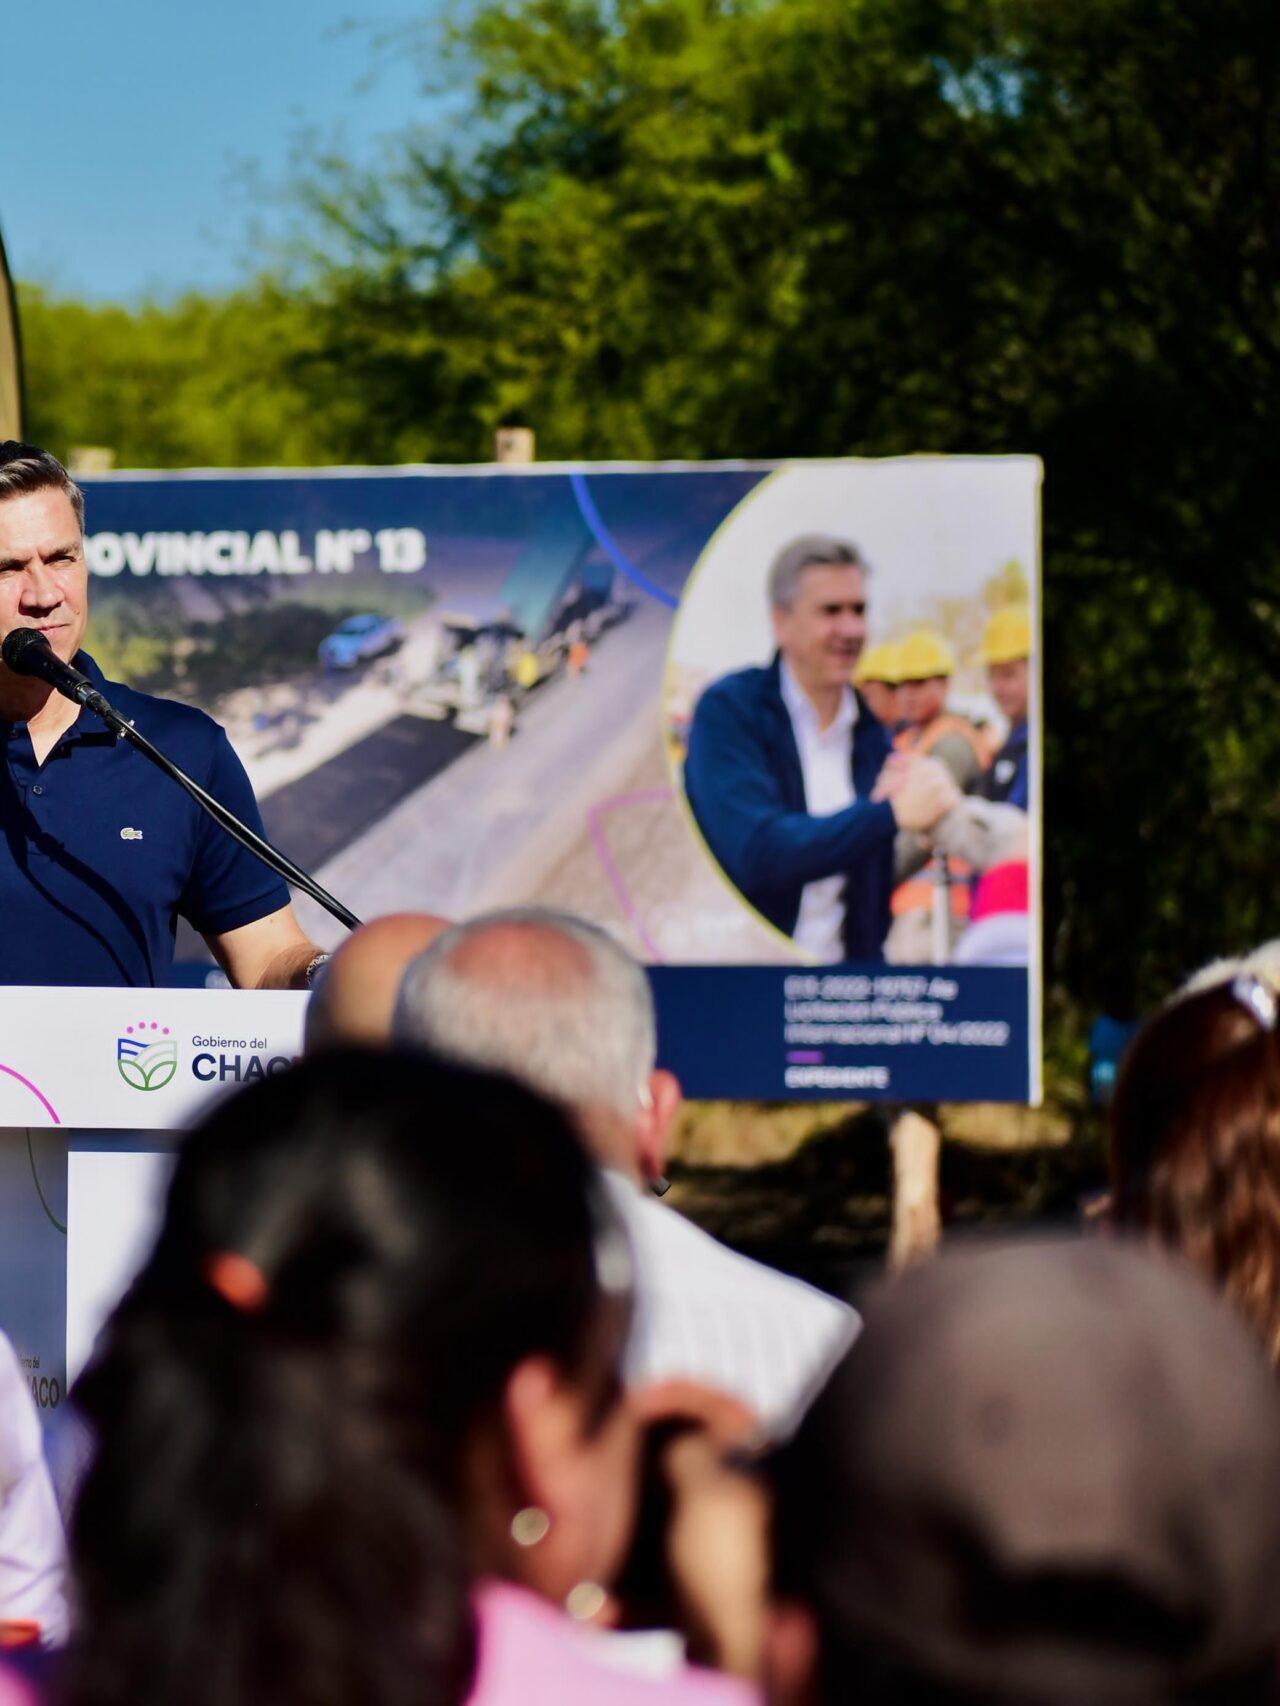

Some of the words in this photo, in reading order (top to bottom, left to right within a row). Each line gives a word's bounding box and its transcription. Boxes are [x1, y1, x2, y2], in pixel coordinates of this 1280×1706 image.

[84, 530, 313, 576] OVINCIAL
[375, 526, 428, 574] 13
[192, 1035, 247, 1048] Gobierno
[249, 1038, 267, 1049] del
[785, 1066, 889, 1088] EXPEDIENTE
[26, 1376, 60, 1408] ACO
